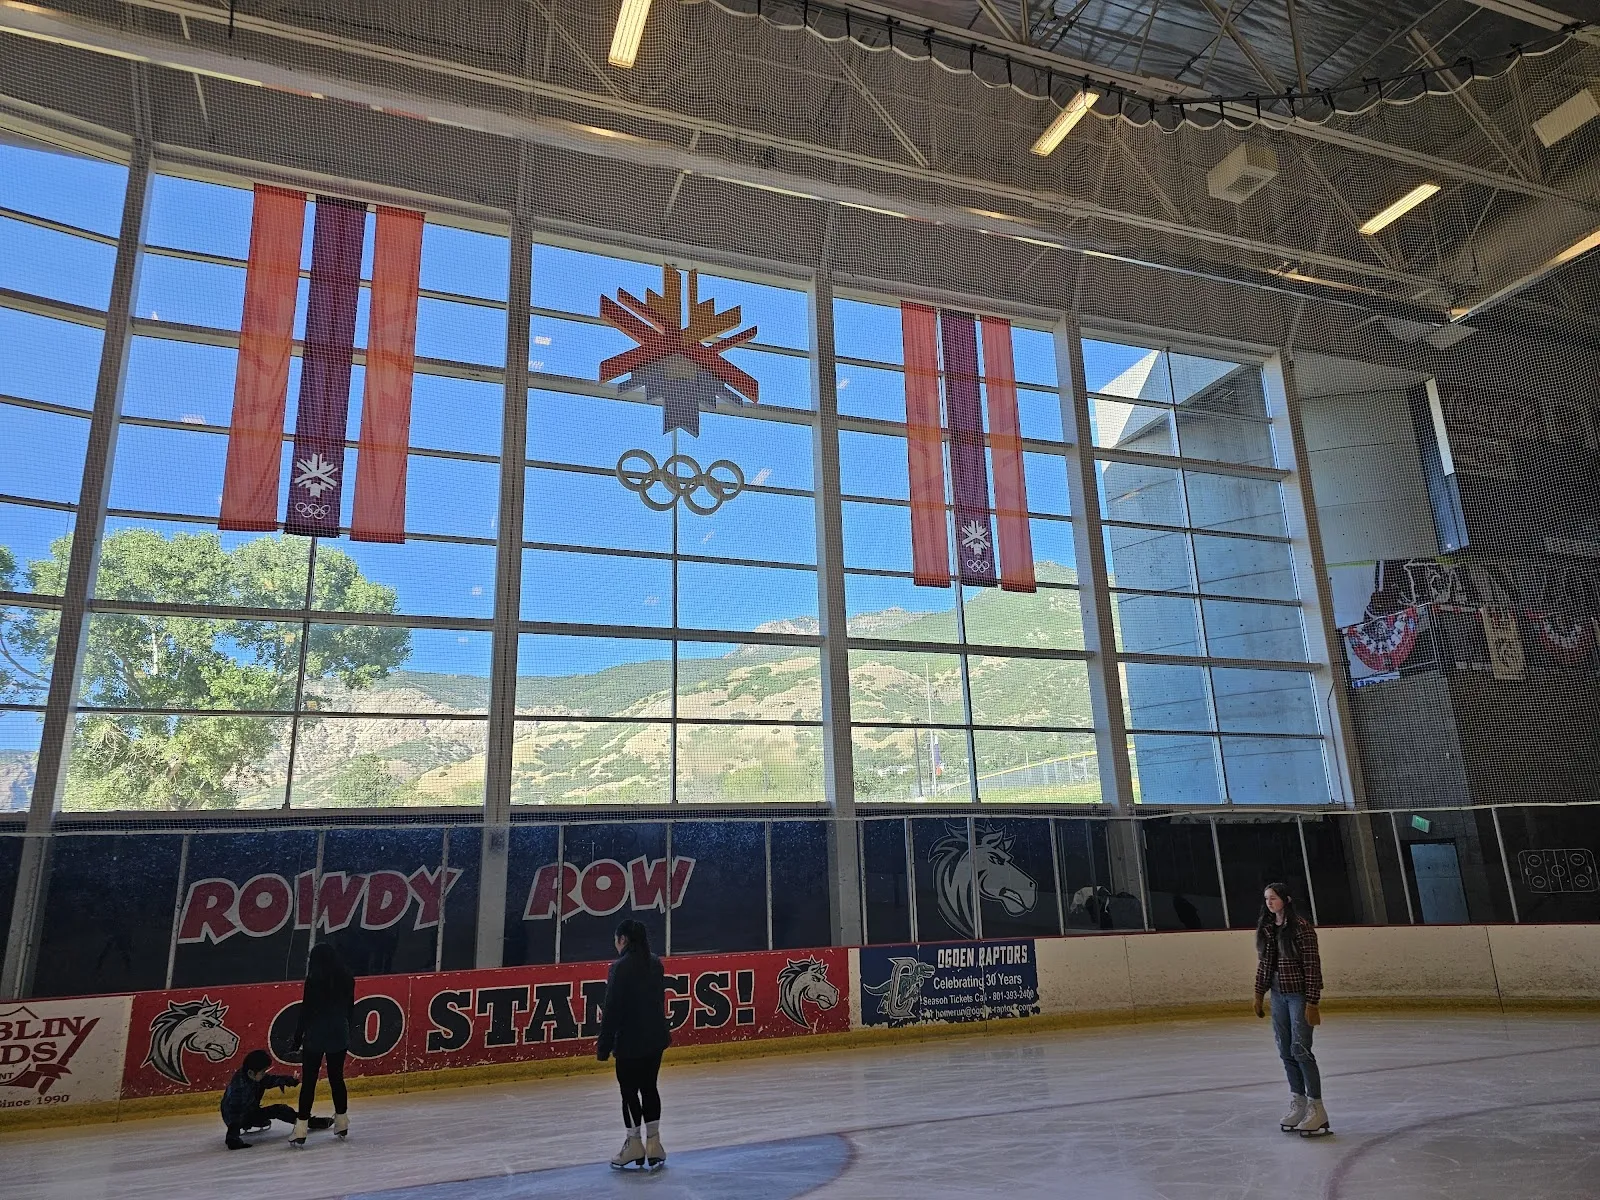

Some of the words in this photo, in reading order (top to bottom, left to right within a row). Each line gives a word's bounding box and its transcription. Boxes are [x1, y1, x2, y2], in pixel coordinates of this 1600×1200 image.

[177, 864, 464, 945] ROWDY
[522, 854, 697, 920] ROW
[937, 948, 975, 969] OGDEN
[978, 945, 1028, 966] RAPTORS
[933, 974, 984, 991] Celebrating
[986, 973, 997, 986] 30
[997, 972, 1023, 985] Years
[923, 994, 949, 1006] Season
[949, 994, 974, 1004] Tickets
[0, 1098, 30, 1108] ince
[37, 1094, 70, 1105] 1990
